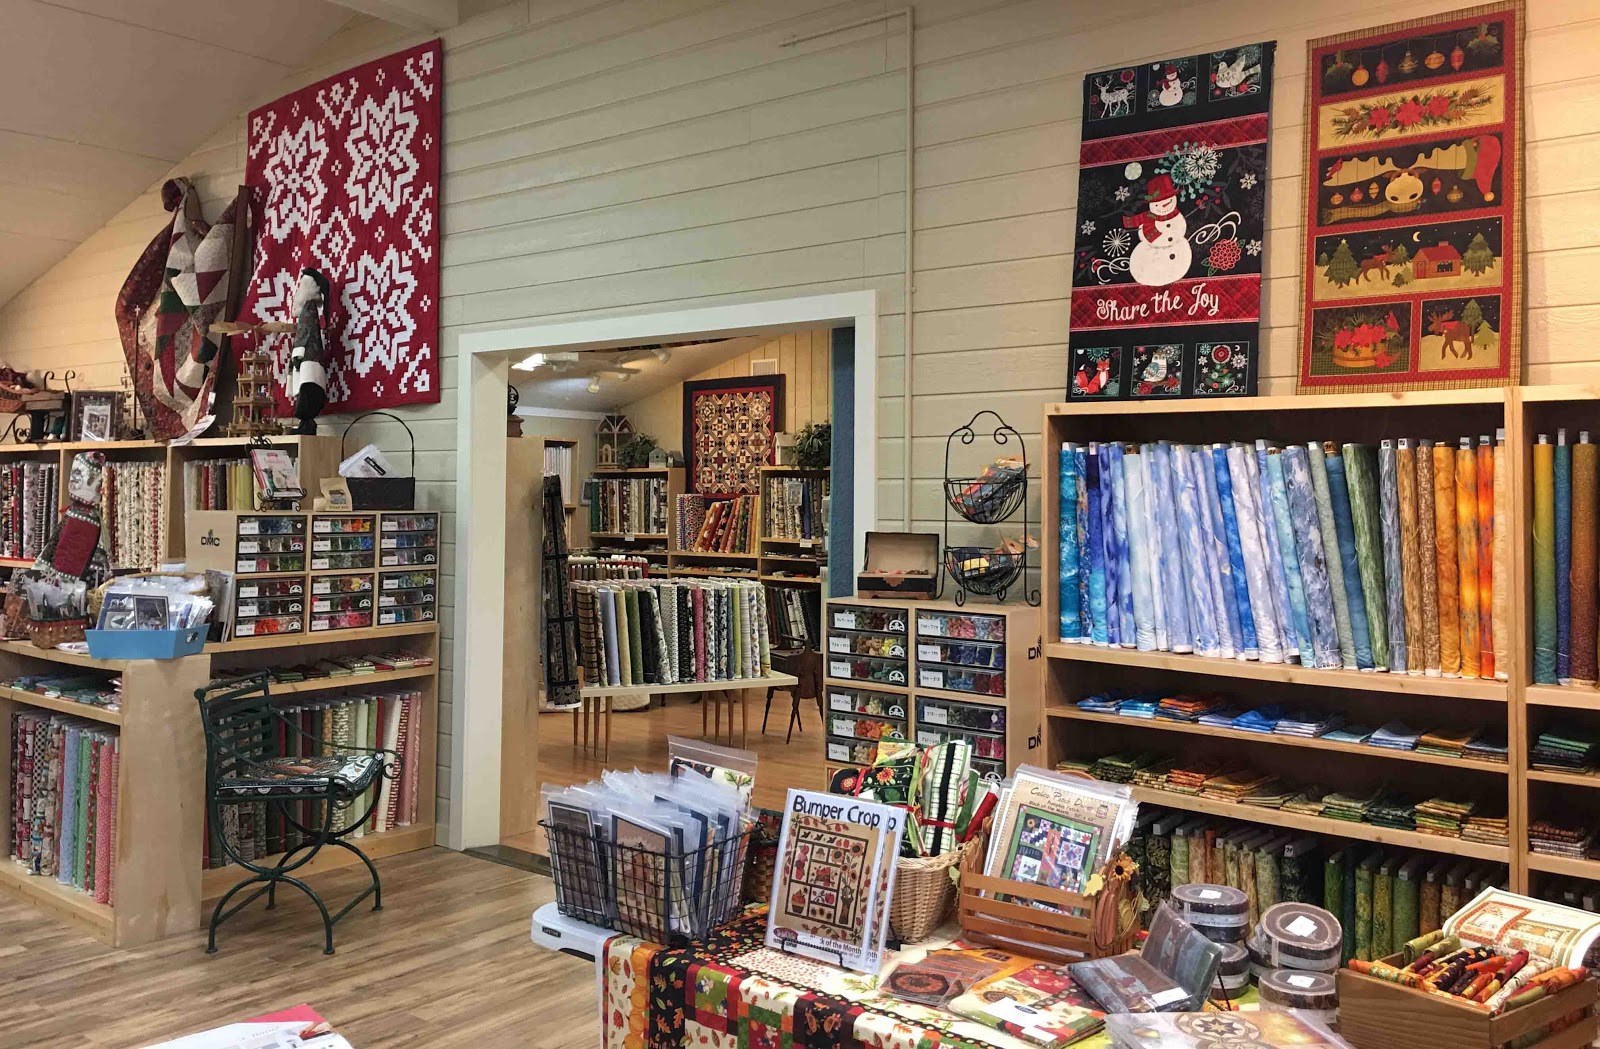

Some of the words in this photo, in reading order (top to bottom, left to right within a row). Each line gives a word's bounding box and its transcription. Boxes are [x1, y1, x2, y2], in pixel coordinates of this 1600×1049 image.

[1096, 298, 1150, 321] Share
[1150, 290, 1184, 314] the
[1187, 282, 1220, 317] Joy
[201, 536, 220, 547] DMC
[1053, 792, 1071, 804] Patch
[792, 795, 844, 820] Bumper
[847, 805, 880, 831] Crop
[833, 941, 842, 949] the
[843, 944, 862, 955] Month
